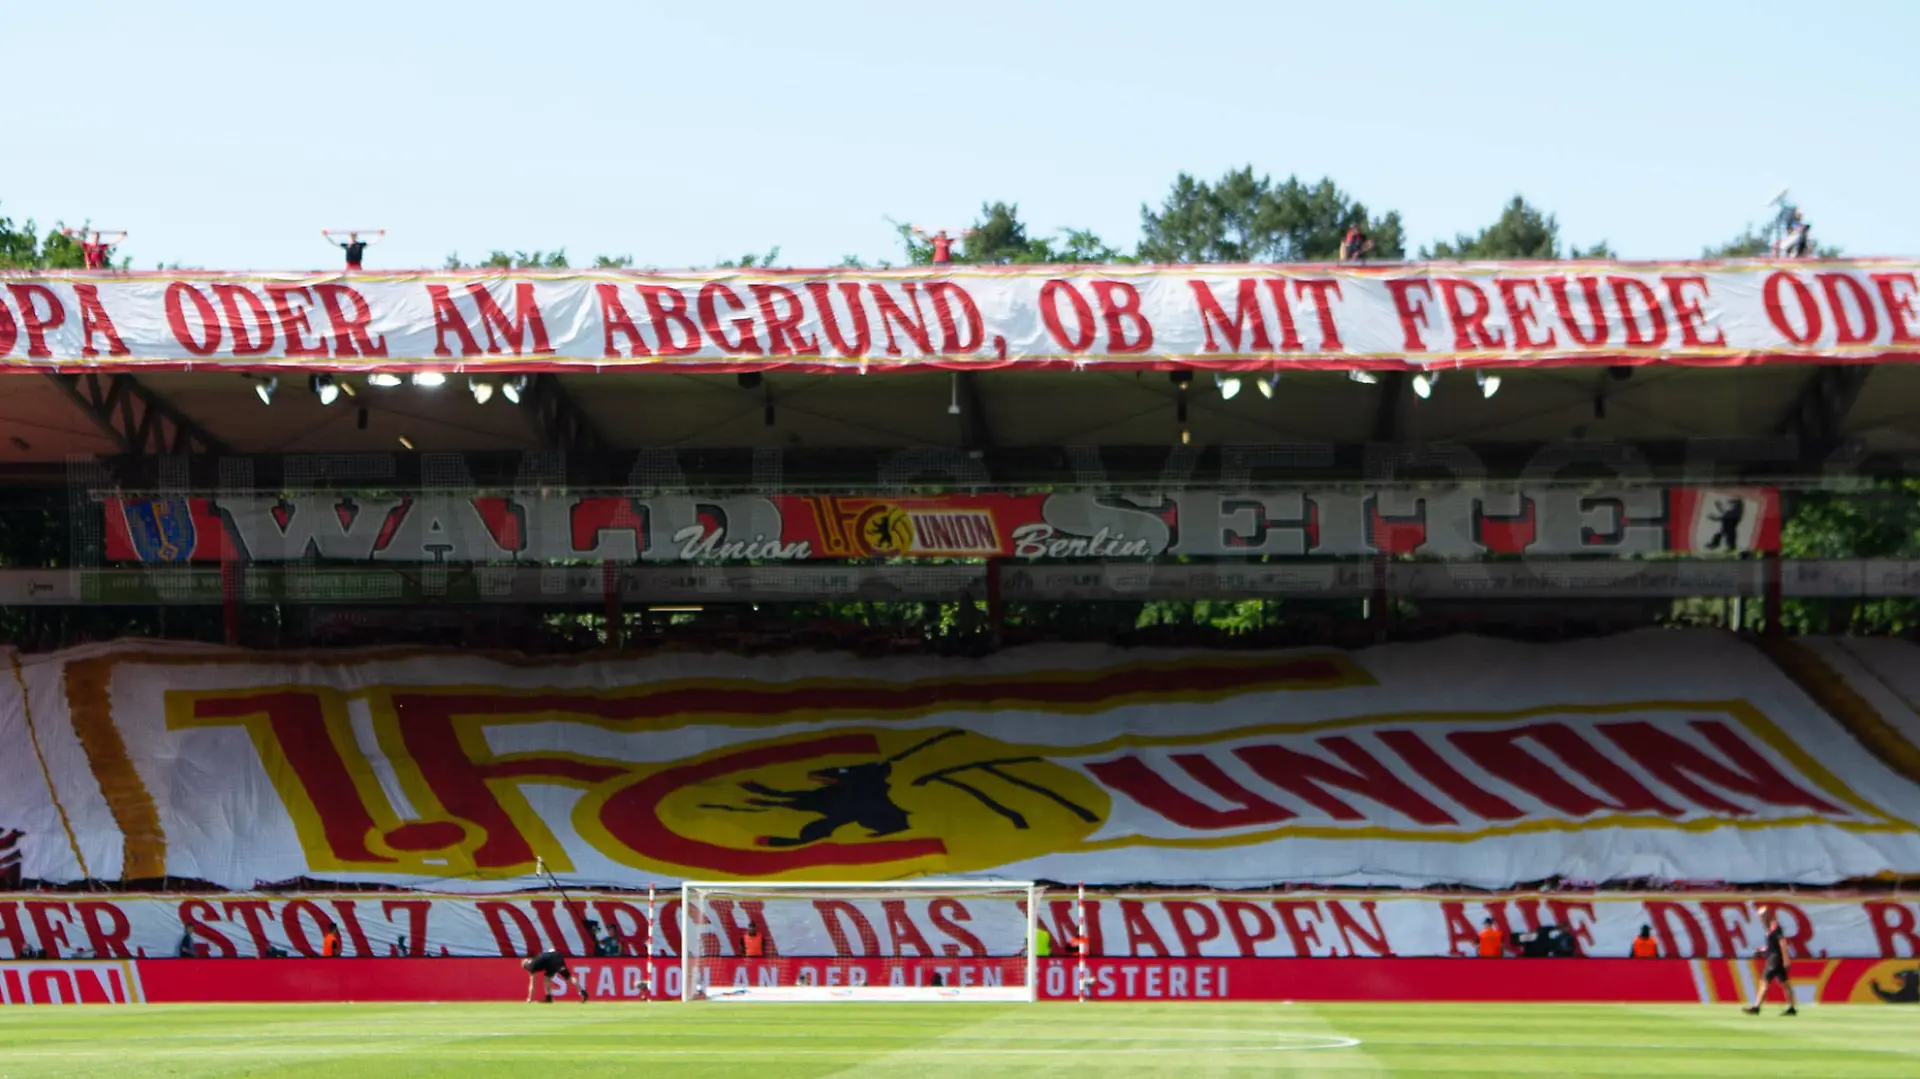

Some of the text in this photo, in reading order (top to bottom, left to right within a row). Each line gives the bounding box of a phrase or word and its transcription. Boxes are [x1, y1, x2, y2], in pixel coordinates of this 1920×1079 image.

[164, 280, 388, 358] ODER
[426, 283, 556, 357] AM
[596, 282, 1007, 361] ABGRUND,
[1038, 279, 1154, 354] OB
[1188, 278, 1344, 353] MIT
[1383, 276, 1727, 350] FREUDE
[213, 492, 1668, 560] WALD SEITE
[673, 522, 1153, 560] Union Berlin
[913, 513, 998, 549] UNION
[1084, 719, 1852, 830] UNION
[178, 899, 449, 957] STOLZ
[476, 900, 780, 957] DURCH
[812, 898, 989, 957] DAS
[1020, 900, 1395, 957] WAPPEN
[1441, 901, 1596, 958] AUF
[1644, 900, 1829, 958] DER
[0, 969, 127, 1004] ION
[732, 966, 779, 988] AN
